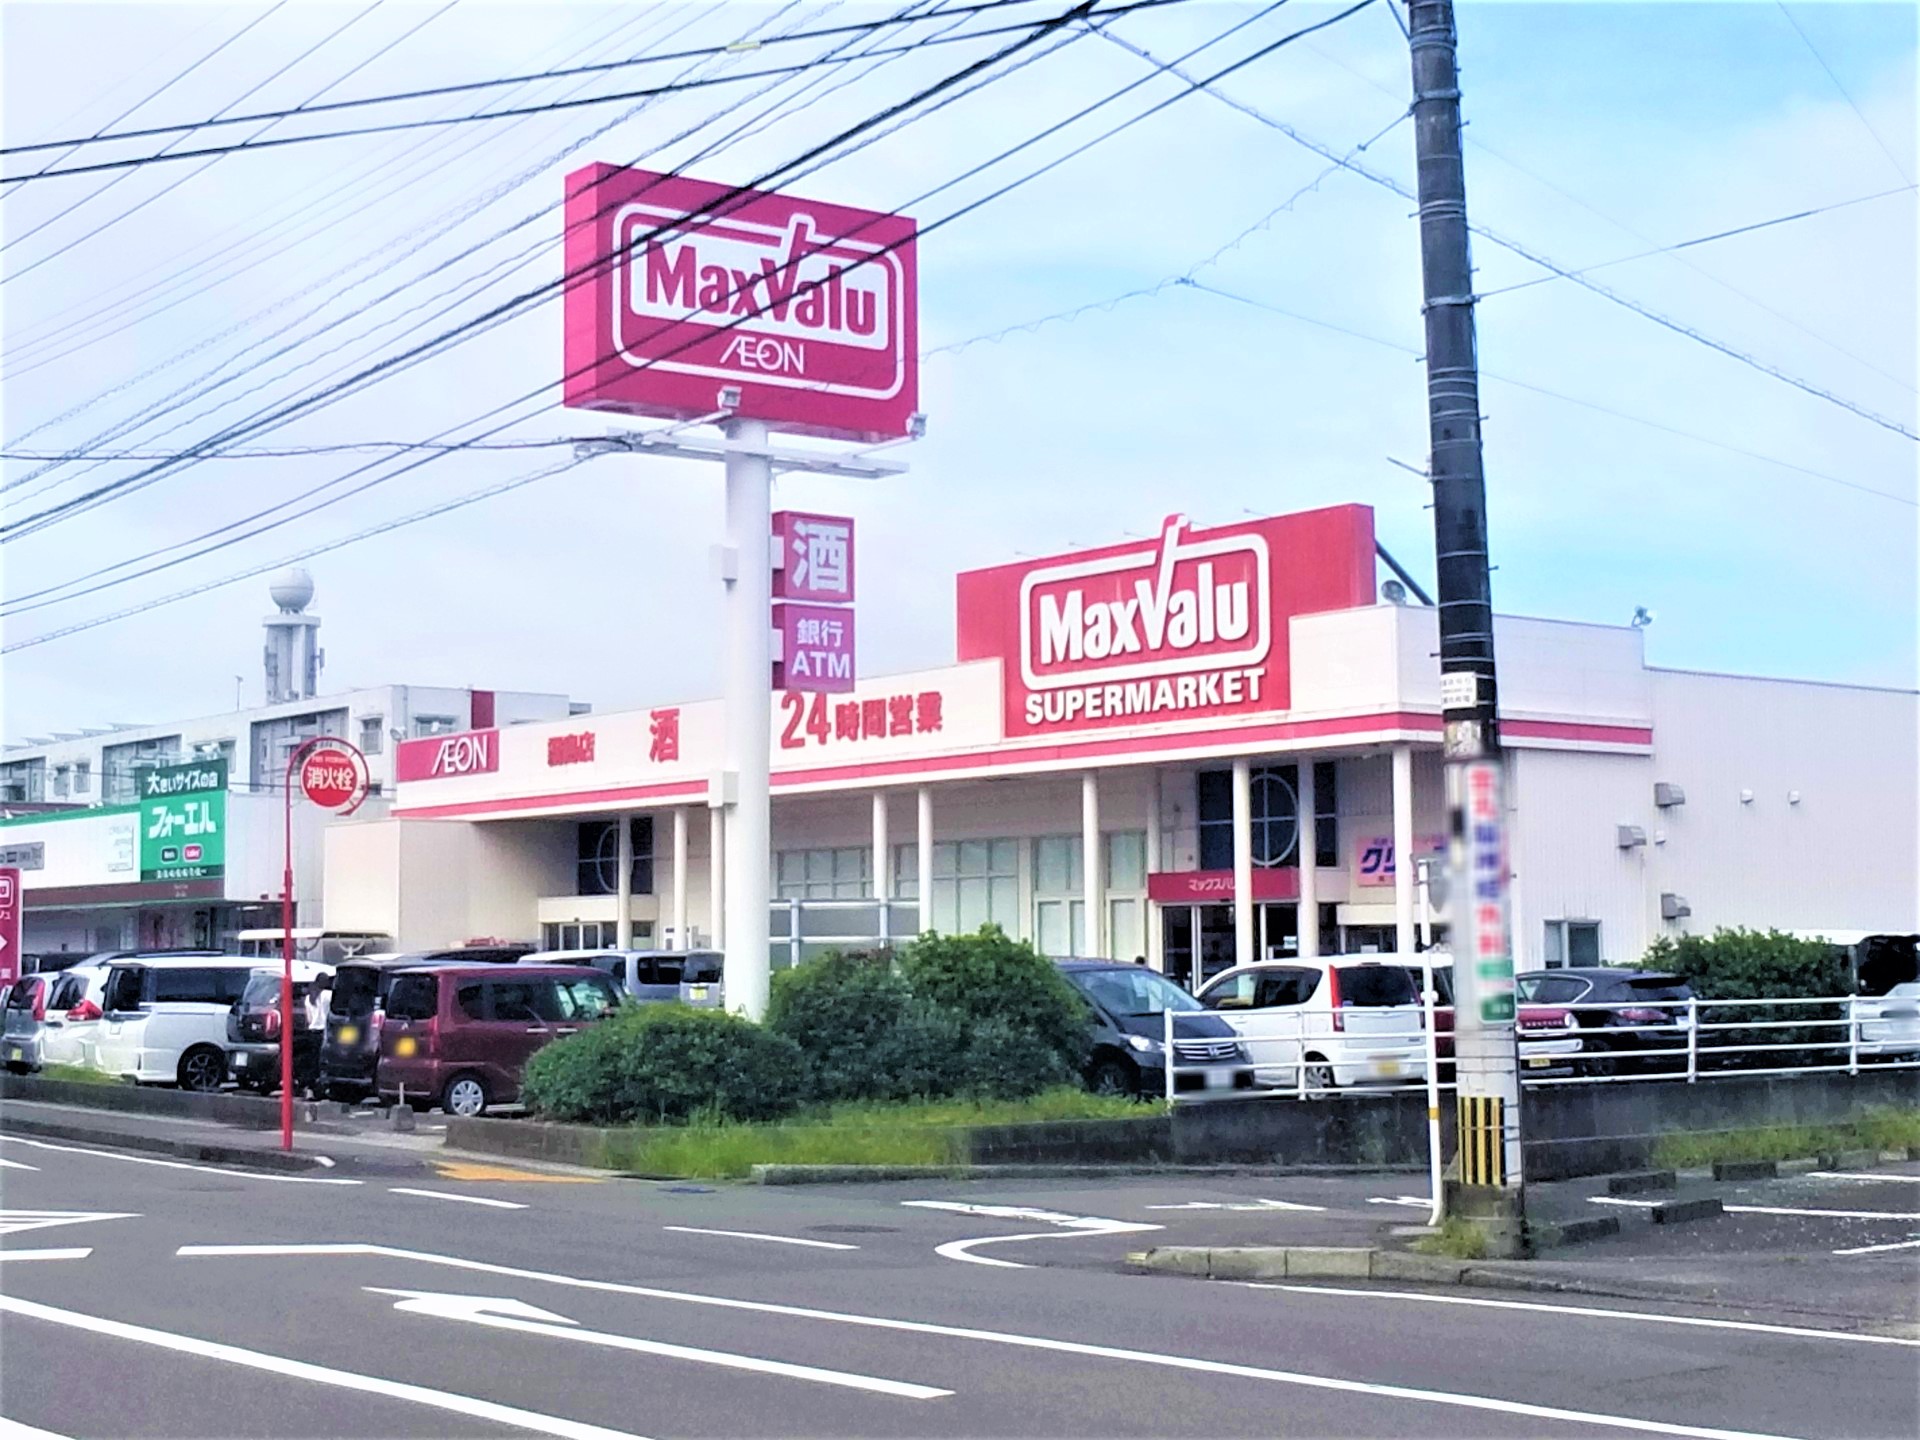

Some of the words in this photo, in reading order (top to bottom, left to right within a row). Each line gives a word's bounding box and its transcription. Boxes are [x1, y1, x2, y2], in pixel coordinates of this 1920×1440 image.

[646, 221, 876, 336] MaxValu
[793, 520, 849, 593] 酒
[1040, 530, 1249, 665] MaxValu
[797, 619, 843, 648] 銀行
[791, 651, 850, 679] ATM
[781, 691, 943, 749] 24時間営業
[1025, 668, 1265, 724] SUPERMARKET
[649, 708, 680, 763] 酒
[147, 770, 219, 794] 大きいサイズの店
[306, 766, 354, 791] 消火栓
[149, 801, 217, 839] フォーエル
